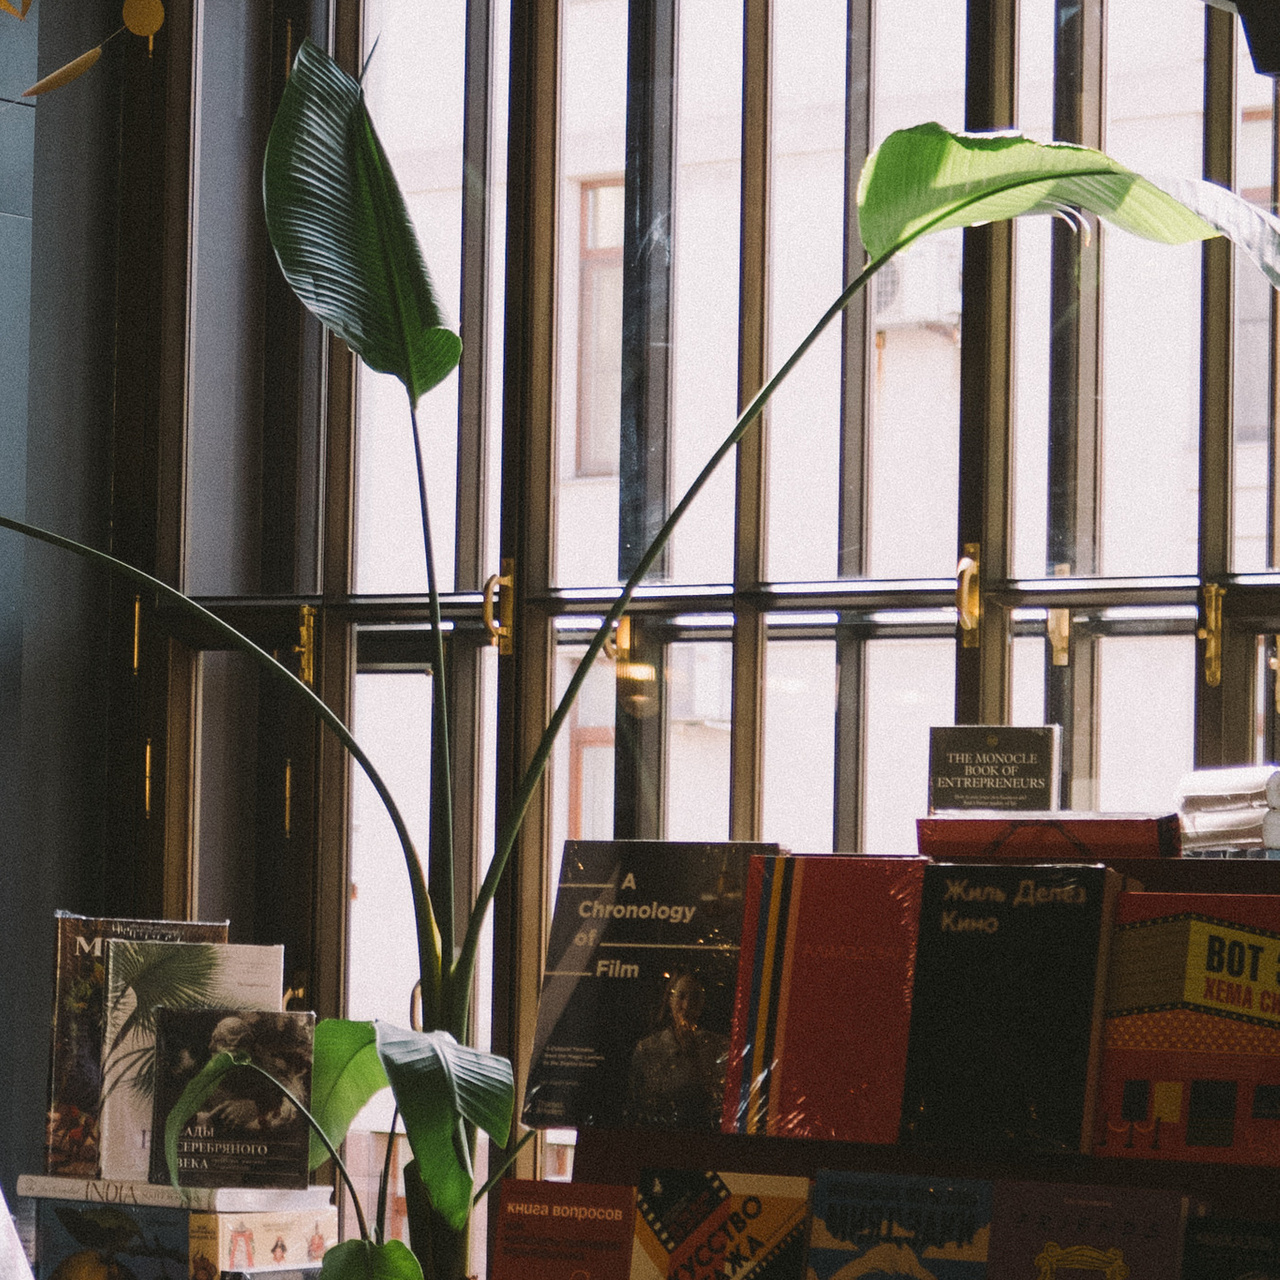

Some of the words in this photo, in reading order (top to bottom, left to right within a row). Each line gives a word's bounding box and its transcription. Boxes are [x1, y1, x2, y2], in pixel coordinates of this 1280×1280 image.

[945, 752, 973, 764] THE
[975, 752, 1038, 764] MONOCLE
[964, 765, 999, 776] BOOK
[1001, 765, 1020, 776] OF
[937, 776, 1046, 788] ENTREPRENEURS
[621, 873, 637, 890] A
[943, 878, 1007, 903] Жиль
[578, 900, 697, 924] Chronology
[940, 910, 1000, 934] Кино
[573, 928, 598, 947] of
[1206, 933, 1265, 982] ВОТ
[595, 960, 640, 978] Film
[182, 1125, 215, 1138] АДЫ
[177, 1141, 269, 1156] СЕРЕБРЯНОГО
[177, 1158, 209, 1170] ВЕКА
[84, 1180, 139, 1206] INDIA
[507, 1203, 549, 1217] книга
[552, 1205, 624, 1221] вопросов
